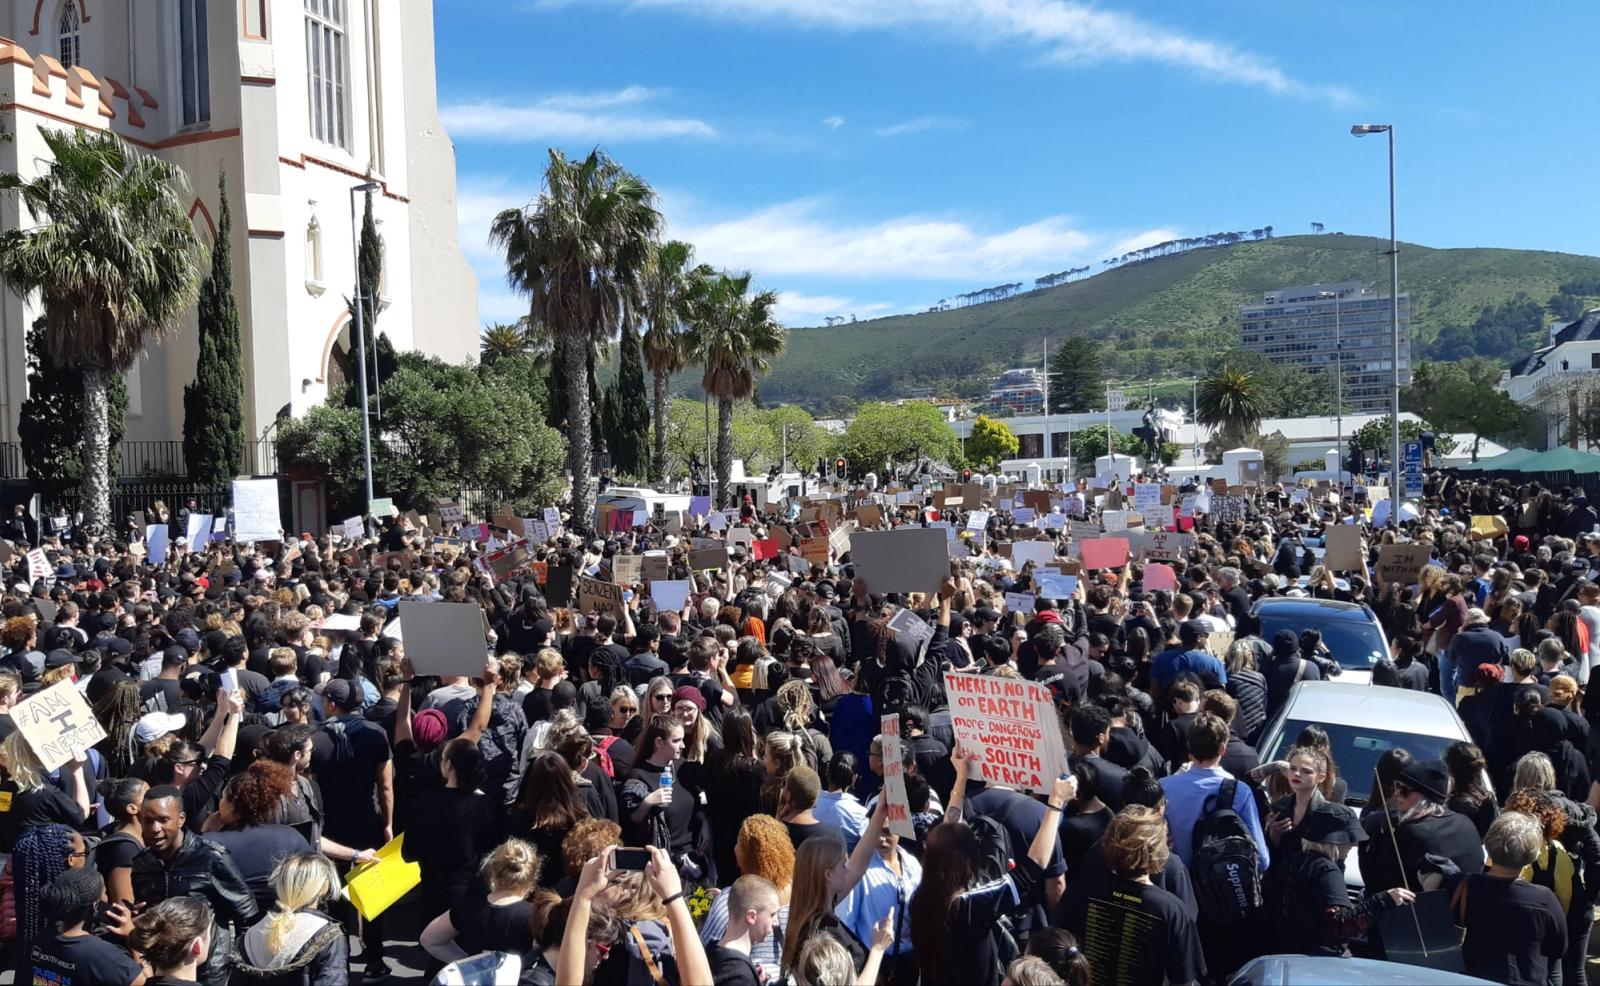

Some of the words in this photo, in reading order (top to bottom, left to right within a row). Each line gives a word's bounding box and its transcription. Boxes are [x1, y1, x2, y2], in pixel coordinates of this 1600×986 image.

[1409, 443, 1418, 453] P
[946, 674, 987, 695] THERE
[989, 680, 1002, 696] IS
[1004, 682, 1025, 697] NO
[978, 696, 1035, 721] EARTH
[953, 716, 985, 730] more
[988, 721, 1042, 739] DANGEROUS
[979, 733, 1035, 752] WOMXN
[985, 747, 1041, 772] SOUTH
[981, 763, 1042, 787] AFRICA
[1226, 863, 1248, 909] Supreme
